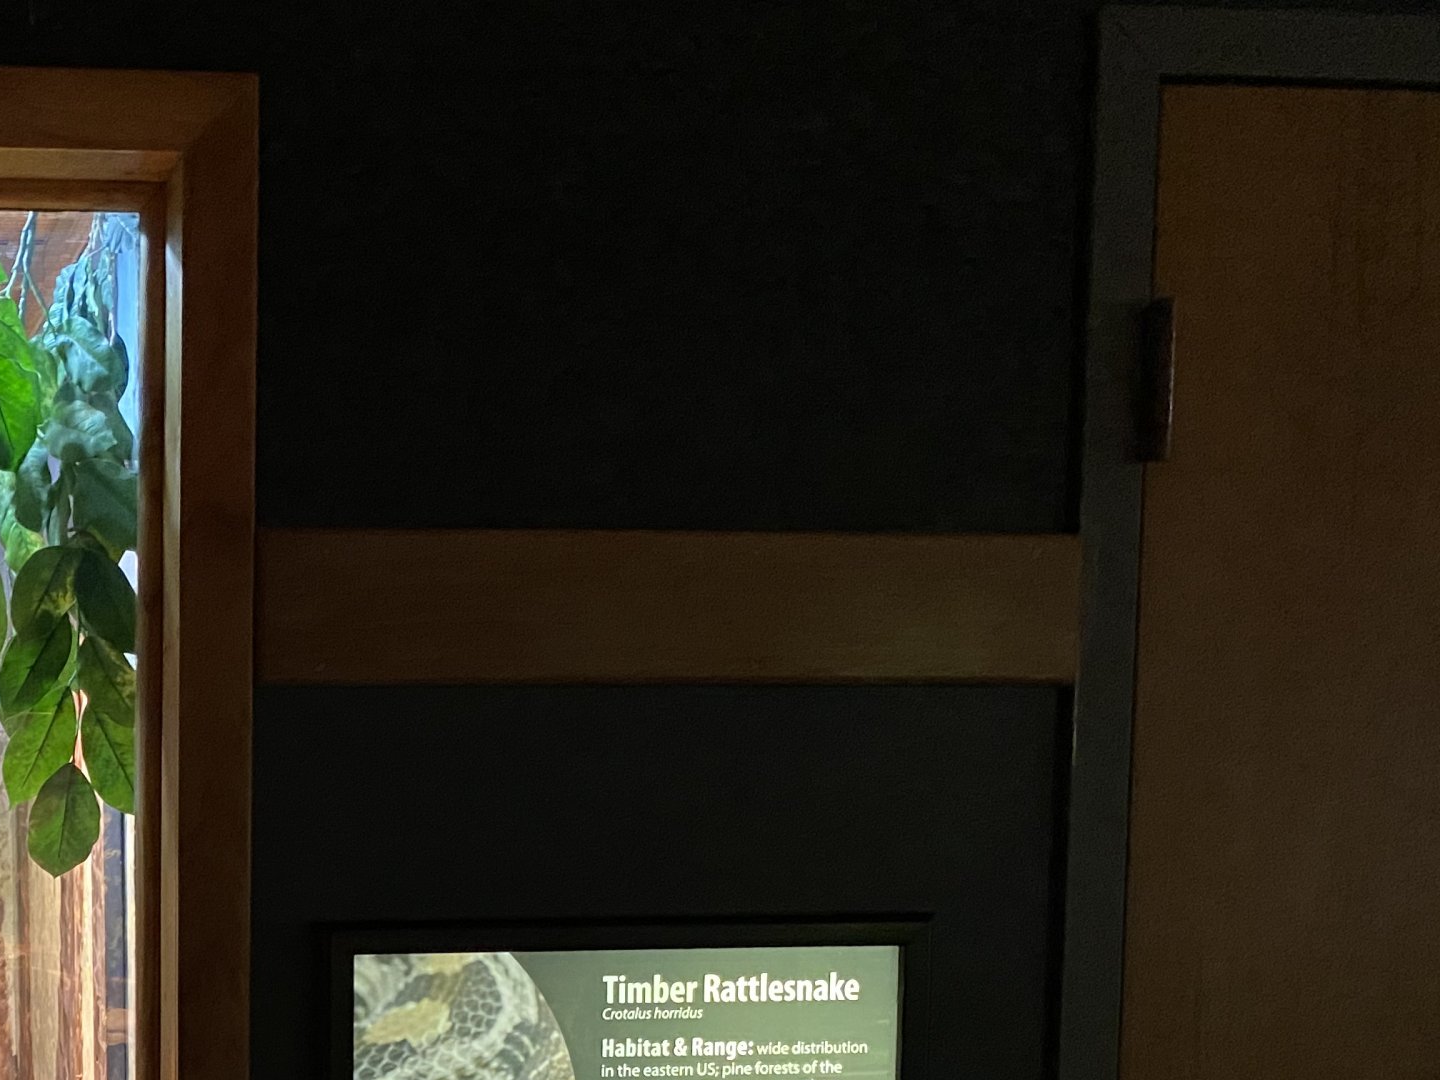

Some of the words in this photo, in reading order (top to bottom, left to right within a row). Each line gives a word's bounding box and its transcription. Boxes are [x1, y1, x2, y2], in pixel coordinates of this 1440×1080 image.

[602, 974, 698, 1003] Timber
[703, 972, 859, 1002] Rattlesnake
[602, 1007, 652, 1020] Crotalus
[653, 1006, 703, 1019] horridus
[601, 1038, 670, 1057] Habitat
[673, 1037, 687, 1056] &
[691, 1038, 754, 1060] Range:
[756, 1042, 789, 1054] wide
[790, 1041, 868, 1054] distribution
[601, 1065, 614, 1077] in
[616, 1064, 640, 1077] the
[642, 1065, 693, 1076] eastern
[696, 1062, 719, 1077] US;
[721, 1062, 752, 1078] pine
[754, 1061, 800, 1074] forests
[801, 1060, 818, 1074] of
[818, 1060, 842, 1073] the
